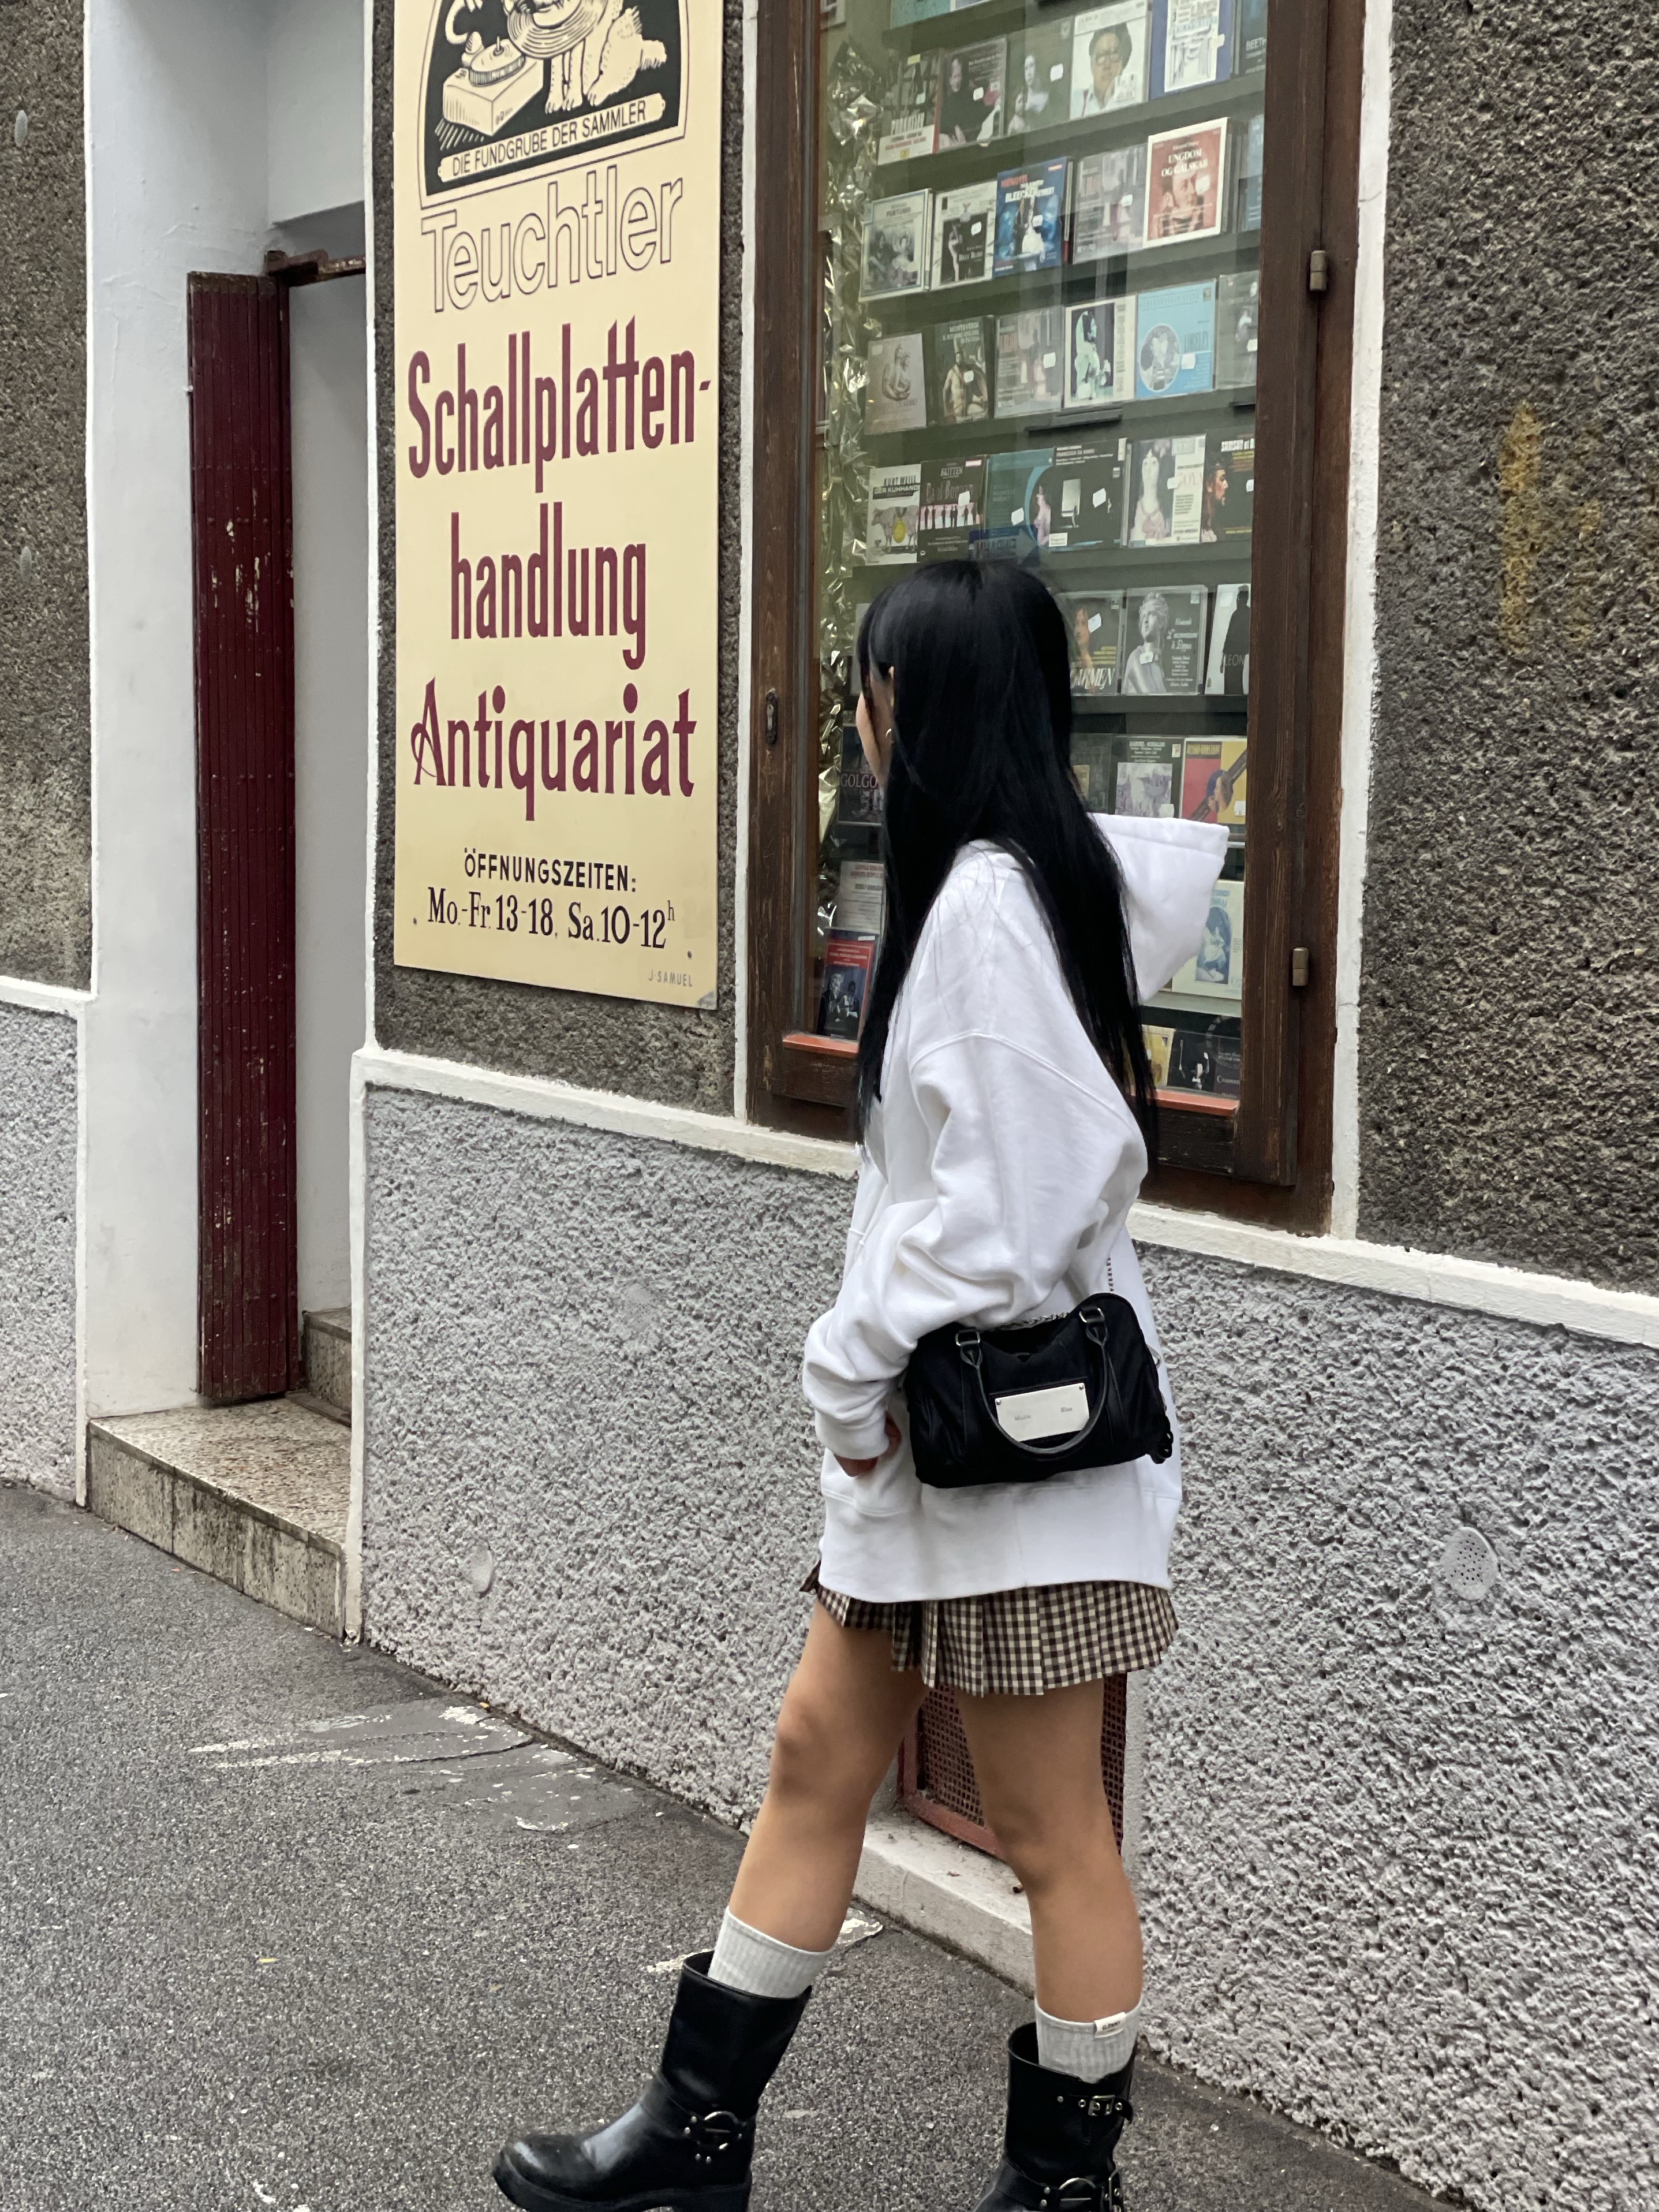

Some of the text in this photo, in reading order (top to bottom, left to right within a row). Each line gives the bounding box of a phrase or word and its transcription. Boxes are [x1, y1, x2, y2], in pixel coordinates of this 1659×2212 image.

[453, 100, 646, 176] DIE FUNDGRUBE DER SAMMLER
[1161, 167, 1172, 177] OG
[1168, 147, 1202, 163] UNGDOM
[421, 165, 683, 314] Teuchtler
[408, 315, 711, 493] Schallplatten-
[940, 466, 963, 477] BRITTEN
[451, 501, 647, 670] handlung
[410, 677, 697, 821] Antiquariat
[464, 848, 636, 892] ÖFFNUNGSZEITEN:
